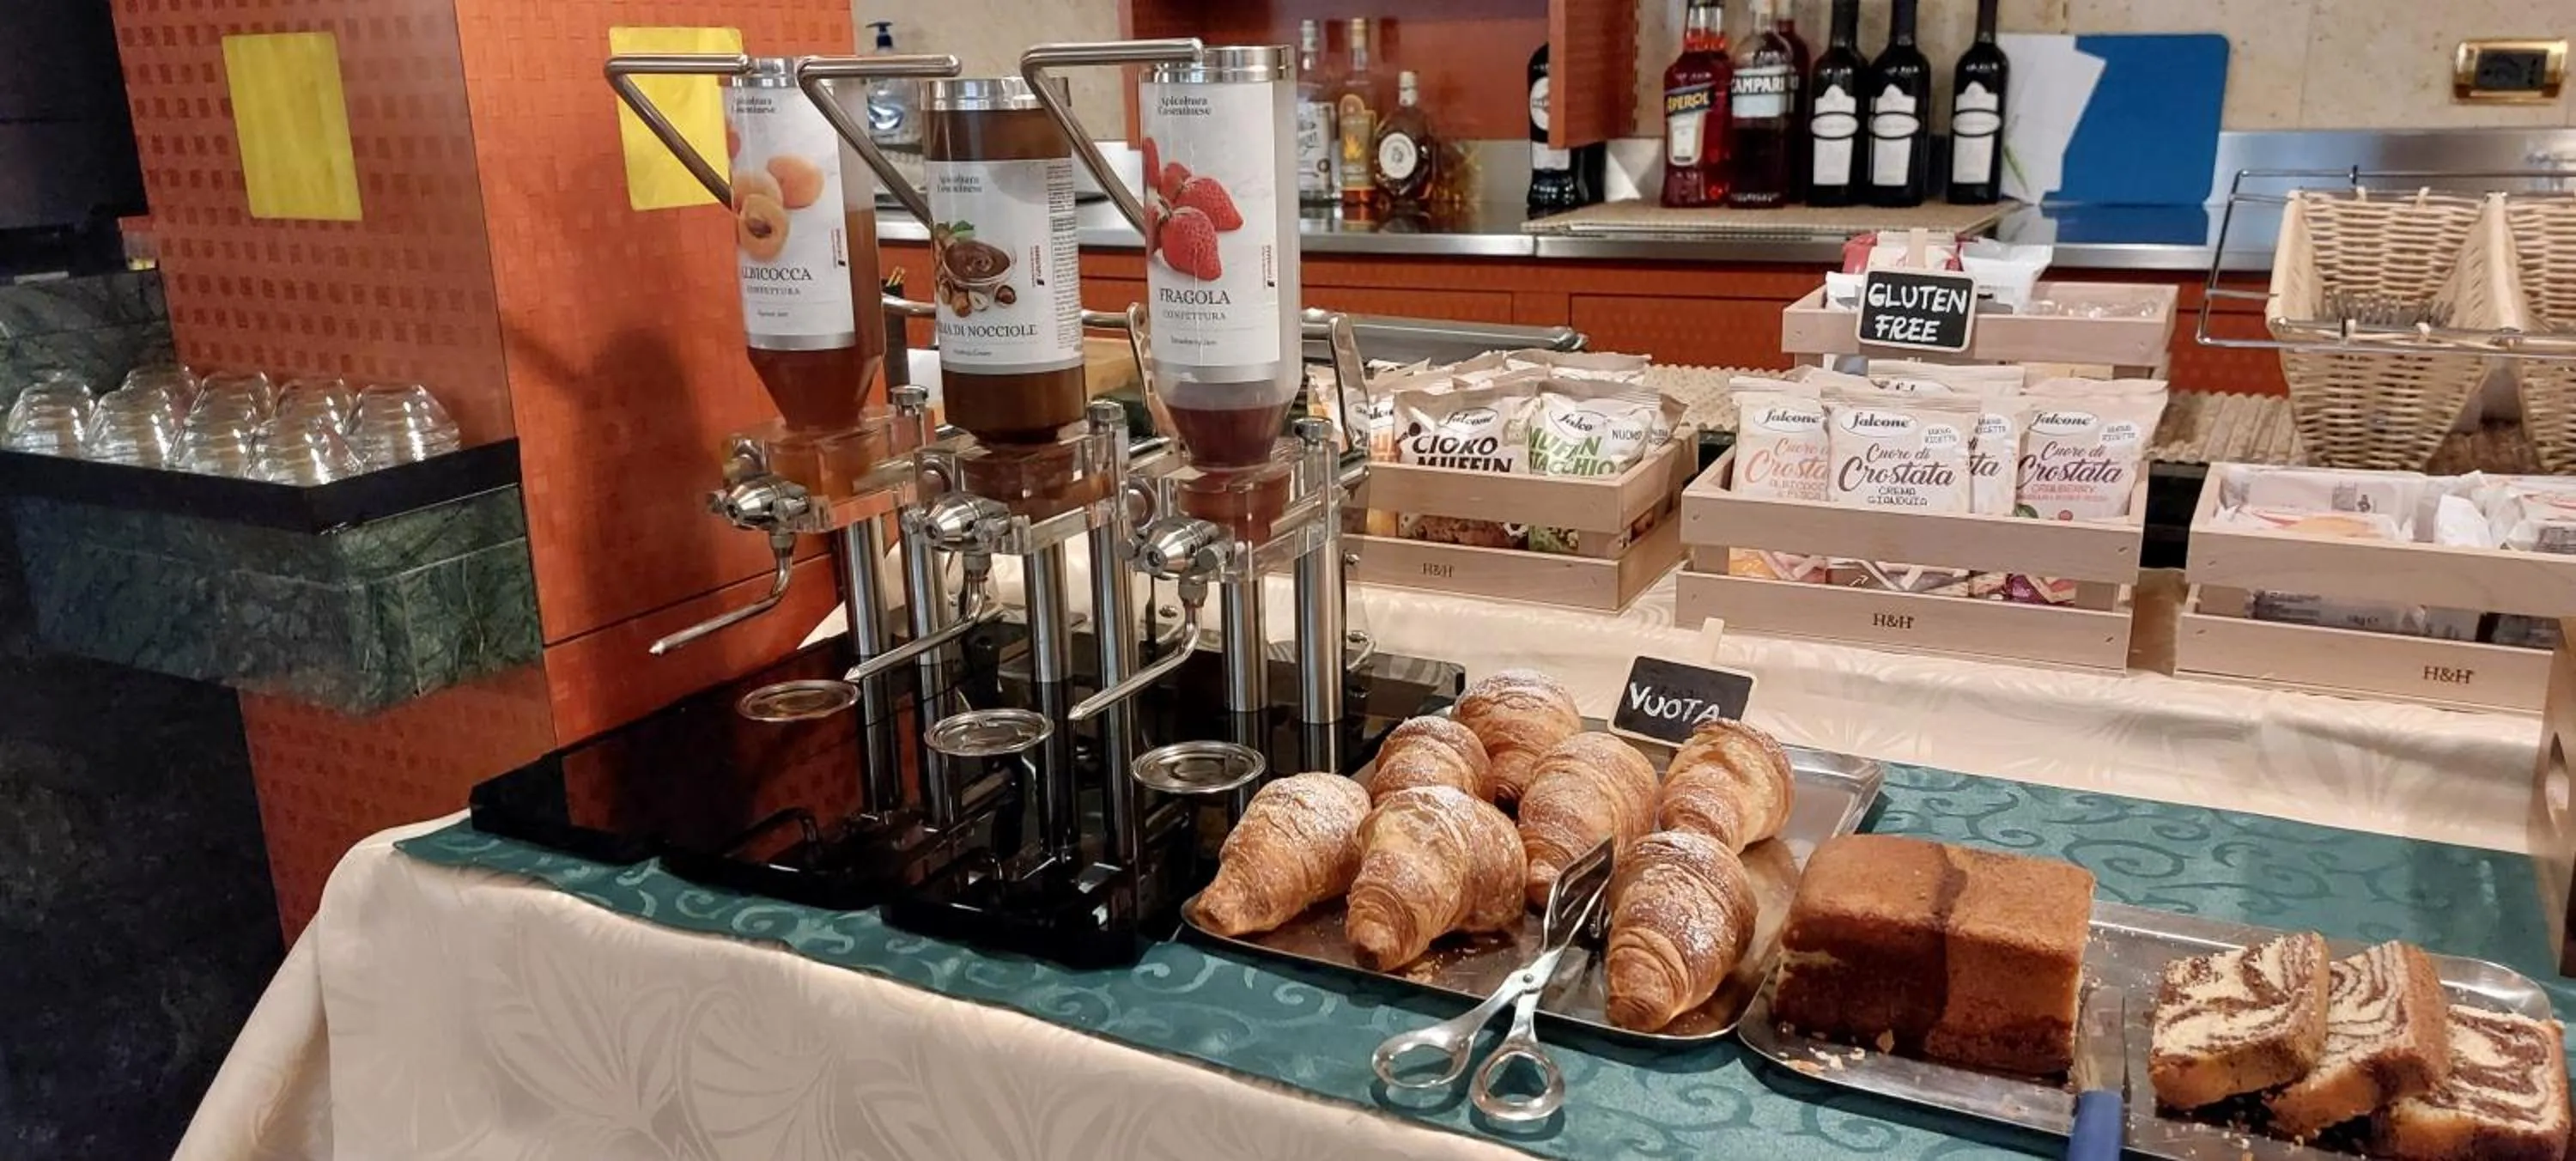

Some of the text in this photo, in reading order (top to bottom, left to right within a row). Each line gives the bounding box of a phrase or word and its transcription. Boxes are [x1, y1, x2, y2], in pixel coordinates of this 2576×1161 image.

[1160, 288, 1231, 305] FRAGOLA
[1868, 283, 1968, 314] GLUTEN
[1874, 314, 1941, 342] FREE
[1412, 435, 1498, 456] CIOKO
[1838, 456, 1955, 492] Crostata
[1630, 682, 1720, 725] VUOTA
